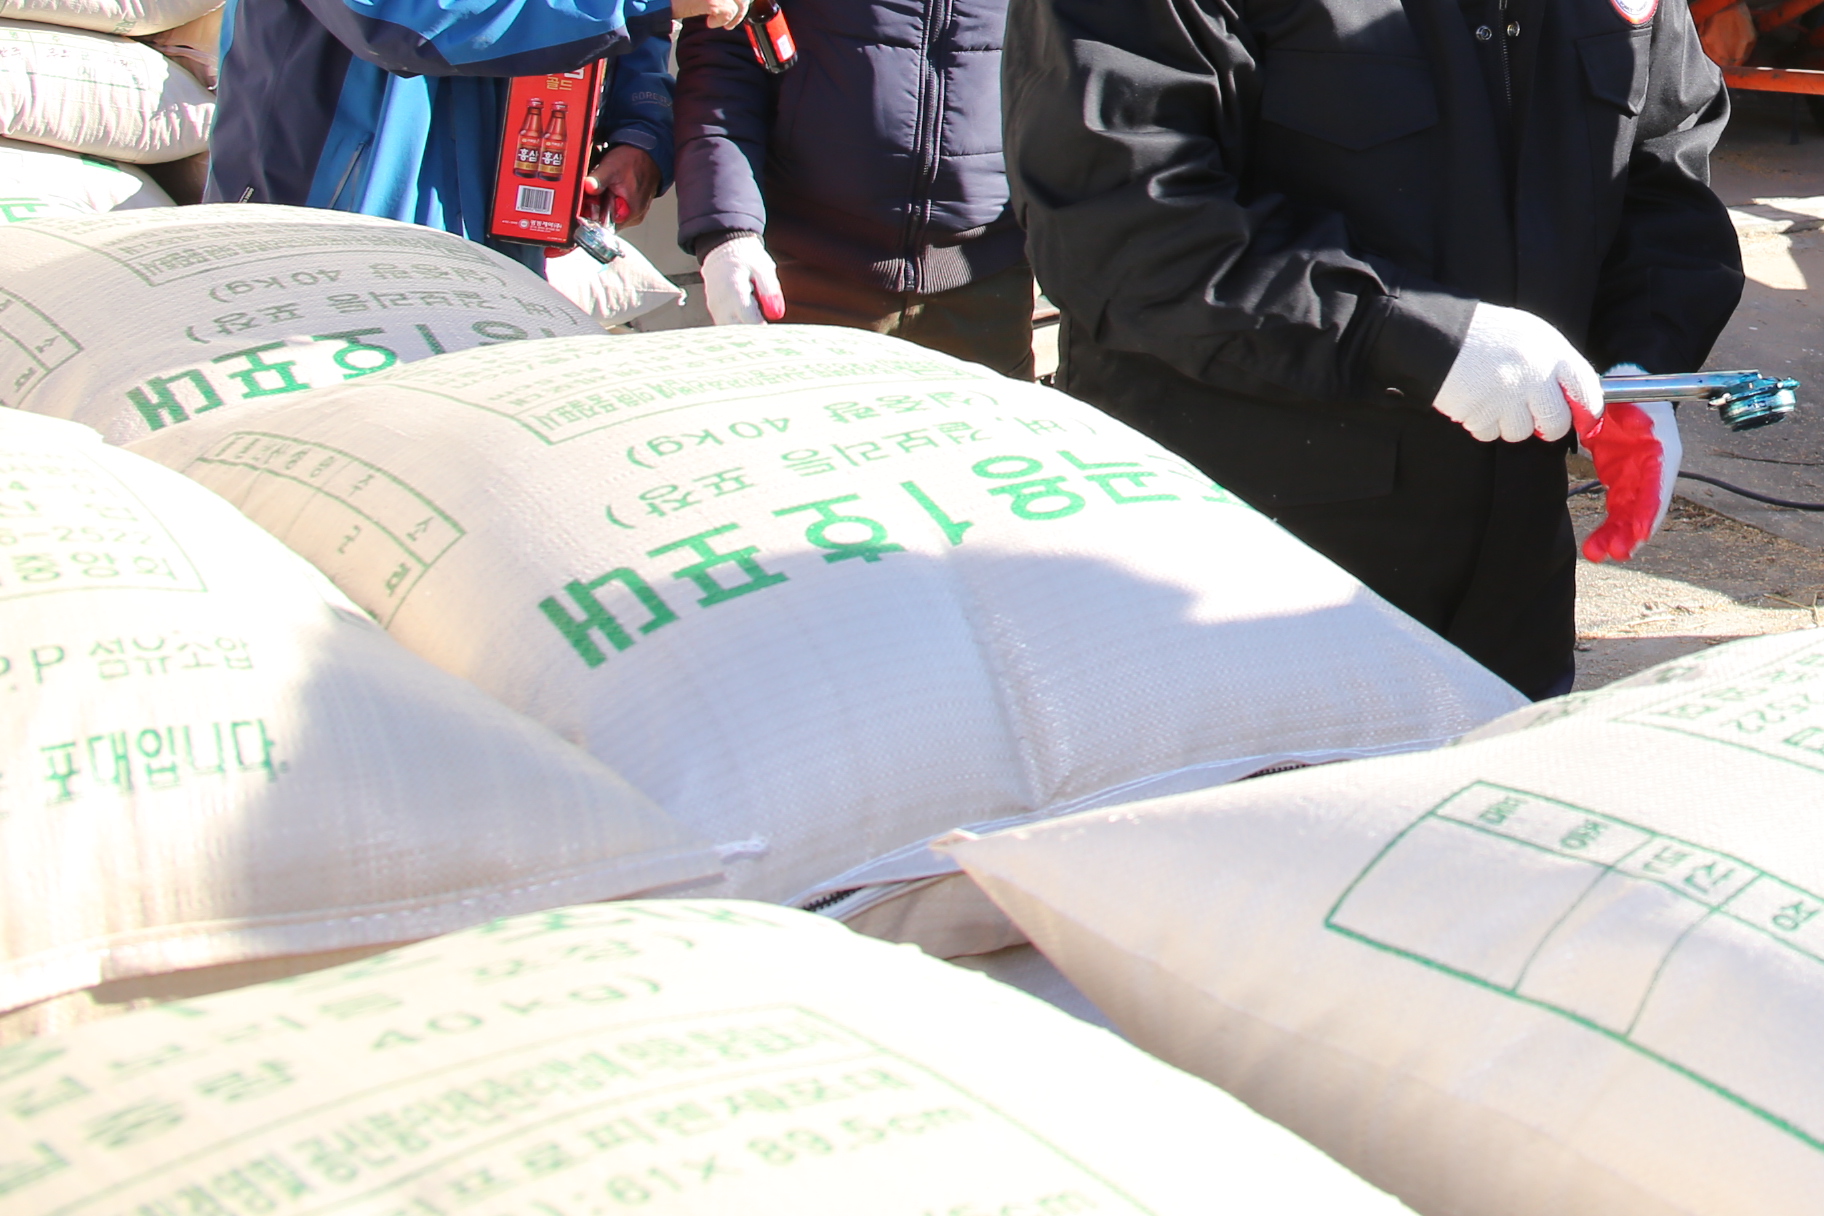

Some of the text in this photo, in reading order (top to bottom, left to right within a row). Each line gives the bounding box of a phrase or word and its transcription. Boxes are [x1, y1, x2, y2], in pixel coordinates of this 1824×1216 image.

[517, 147, 539, 163] 홍삼
[541, 150, 564, 166] 홍삼
[208, 268, 341, 305] 40kg)
[625, 417, 792, 469] 40kg)
[604, 464, 758, 529] 포장)
[369, 976, 662, 1053] 40kg)
